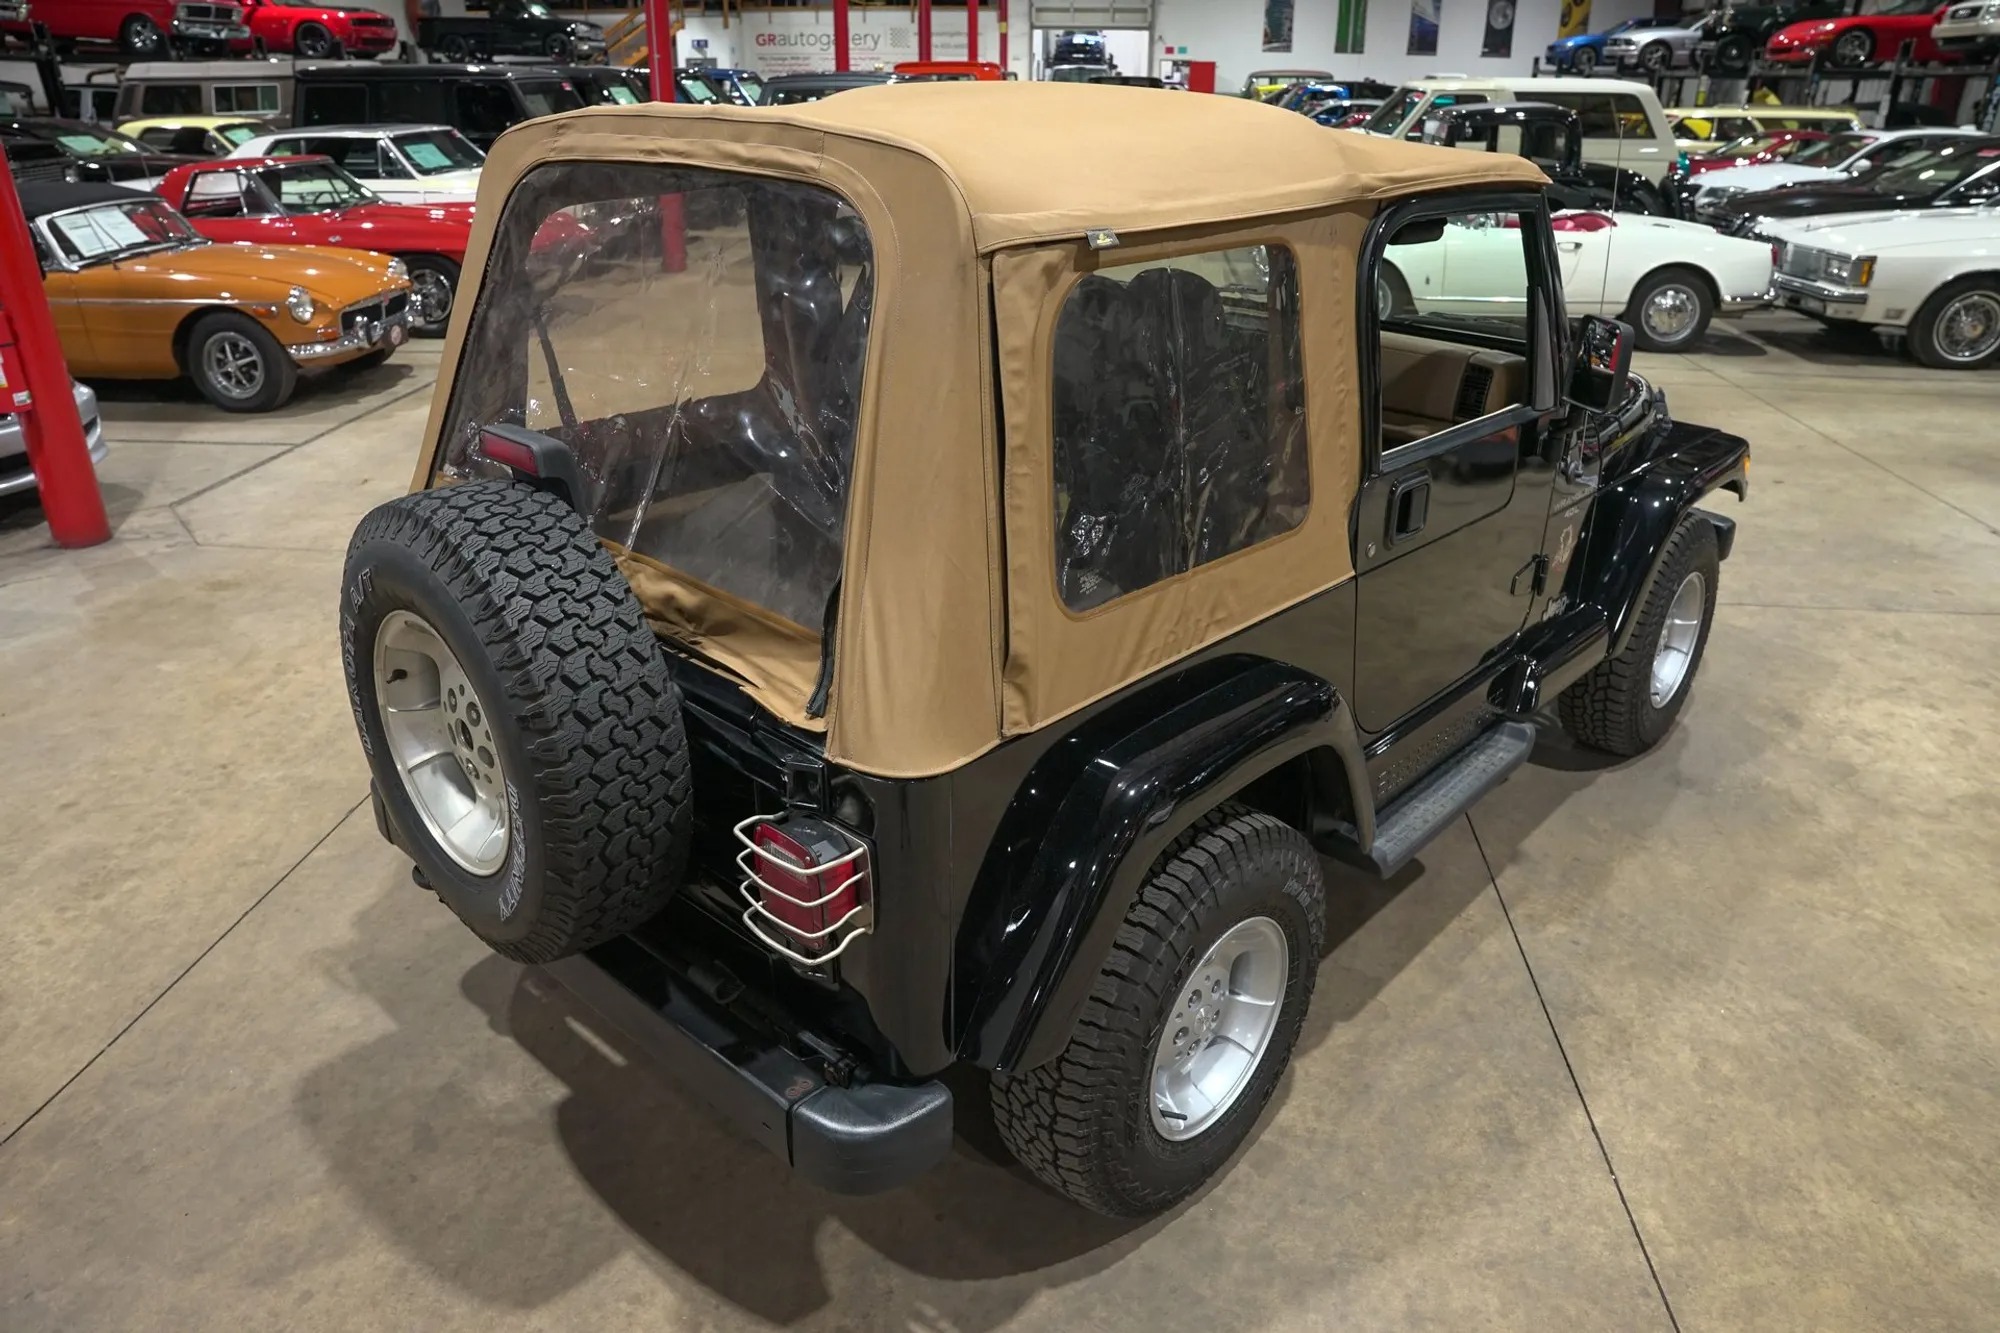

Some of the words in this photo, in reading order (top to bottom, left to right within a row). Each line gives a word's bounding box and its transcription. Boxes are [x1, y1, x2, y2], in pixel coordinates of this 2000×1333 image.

[755, 32, 880, 52] GRautogery
[350, 568, 372, 613] A/T
[499, 779, 526, 921] DEFINITY
